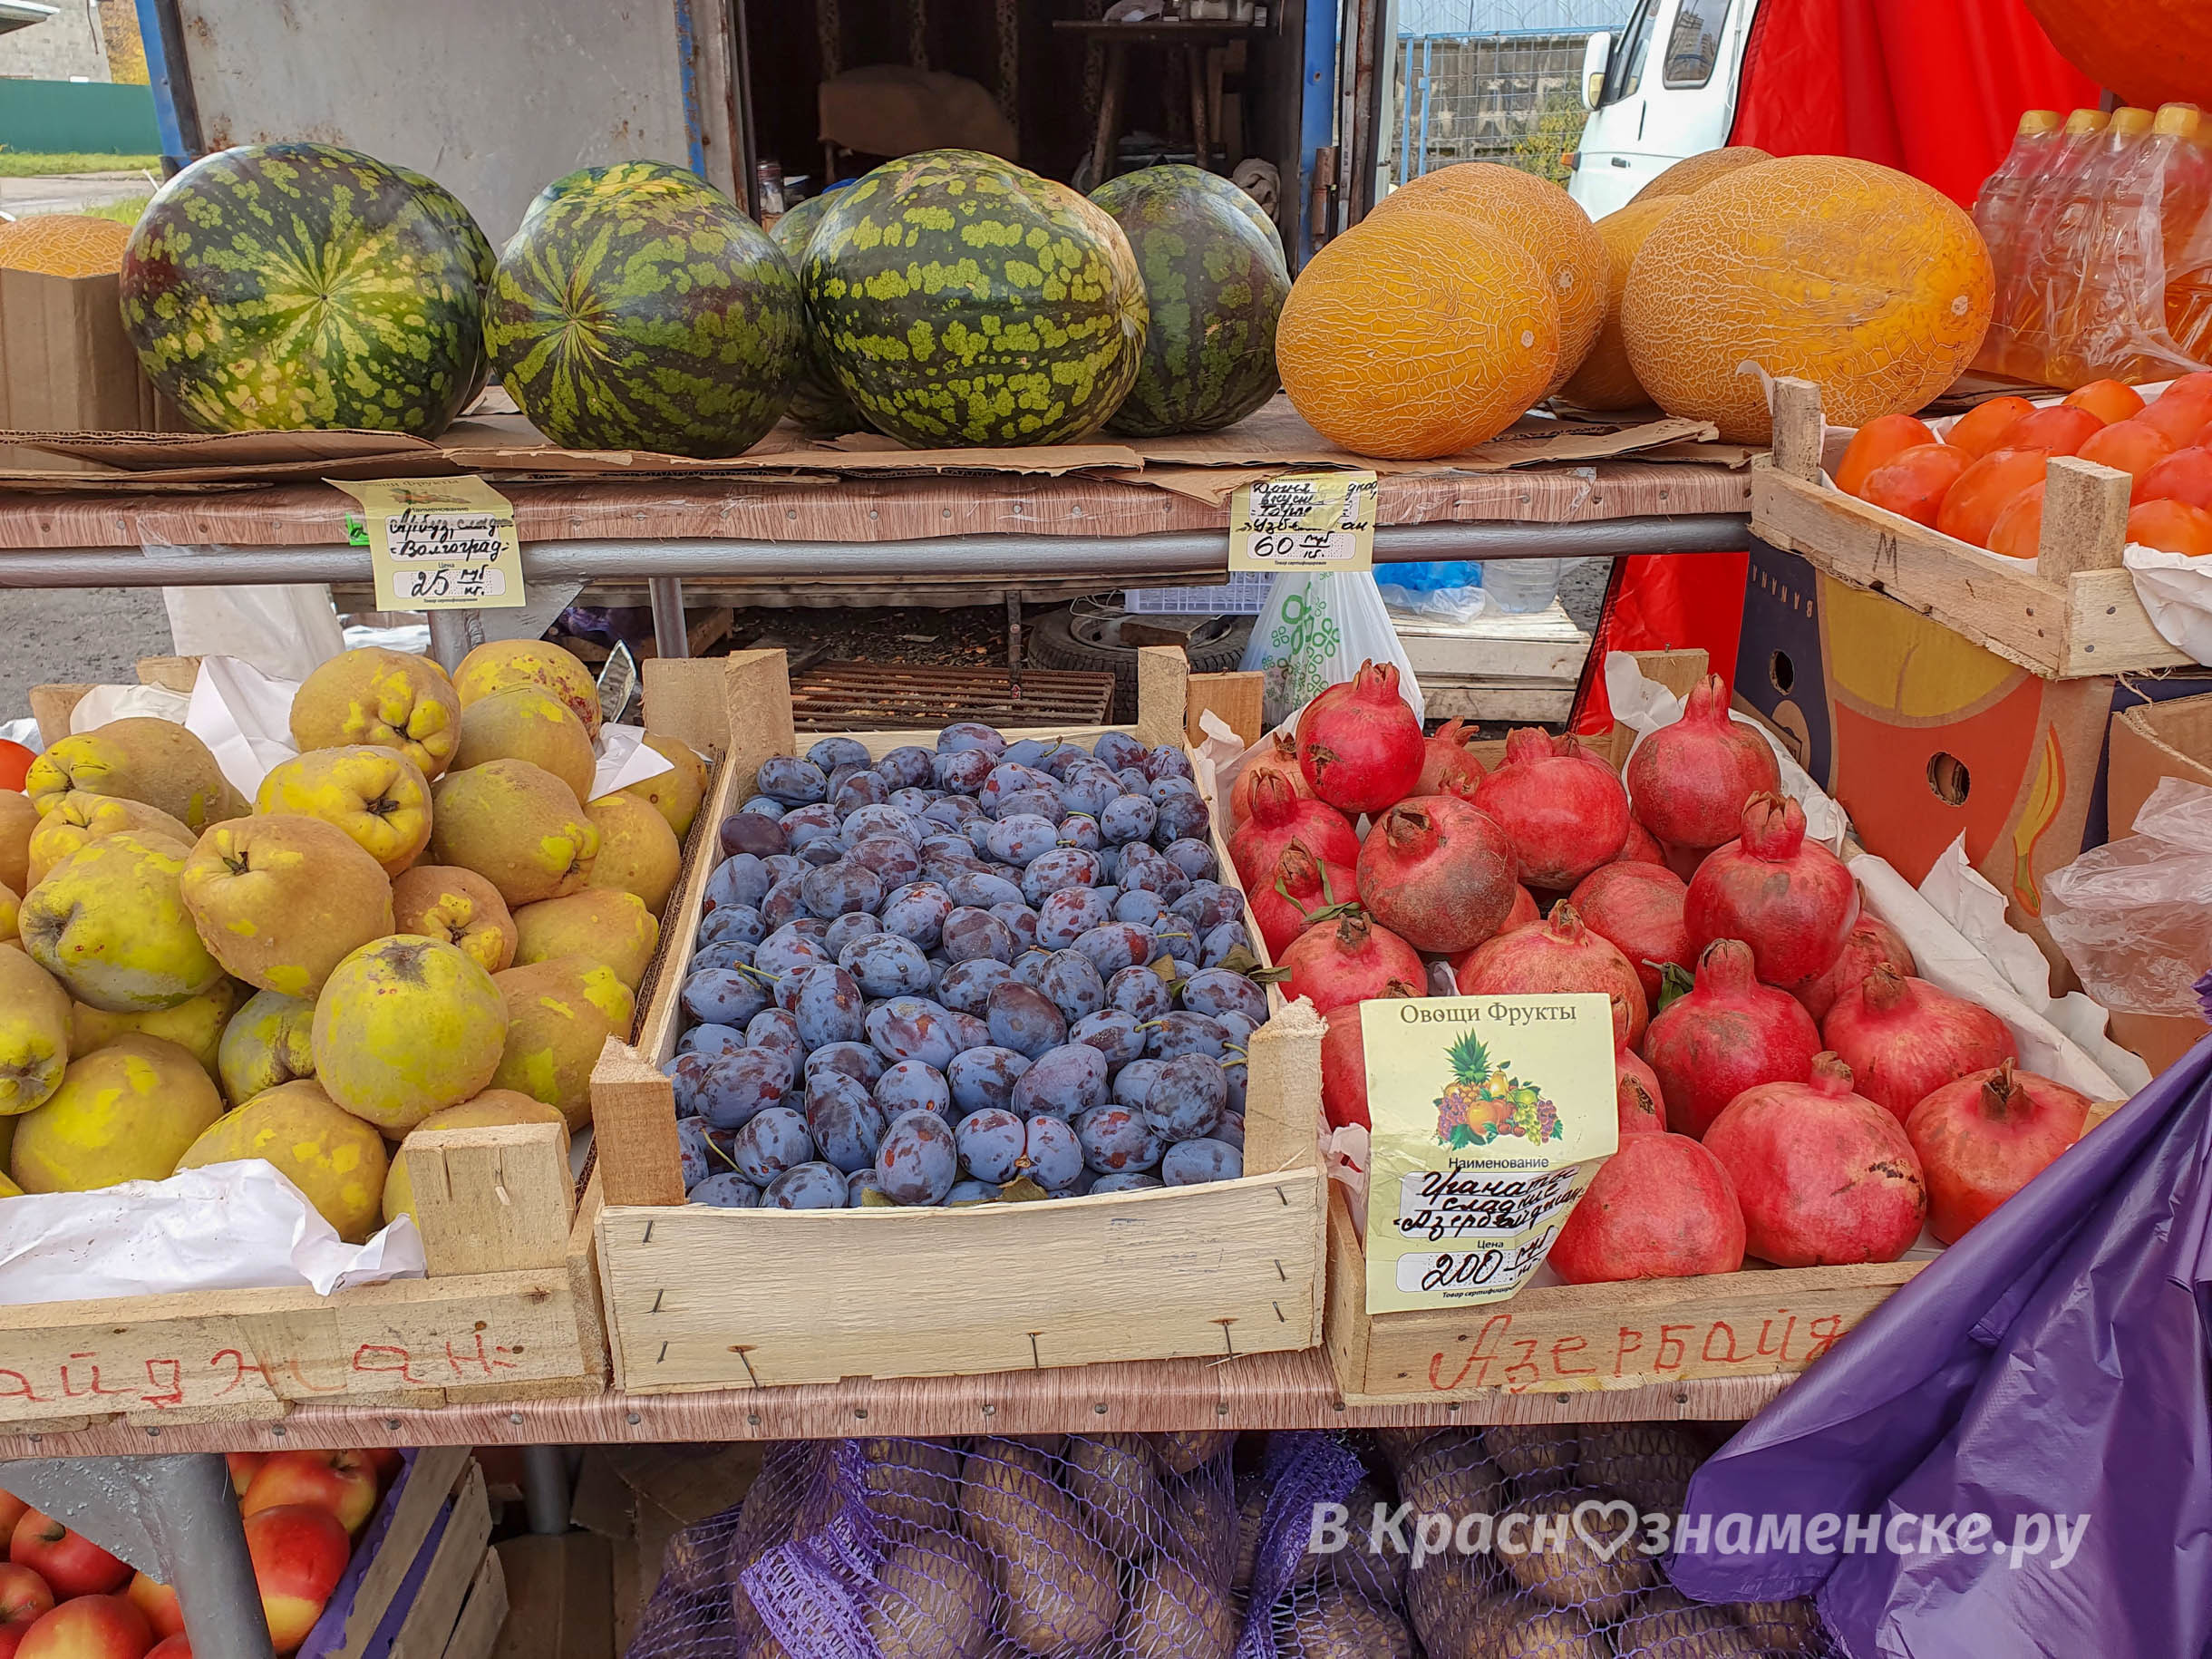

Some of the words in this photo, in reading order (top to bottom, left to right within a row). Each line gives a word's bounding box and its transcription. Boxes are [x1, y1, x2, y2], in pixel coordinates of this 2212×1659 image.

[1254, 536, 1294, 557] 60
[411, 569, 450, 597] 25
[1751, 563, 1814, 618] BANANA
[1401, 1004, 1481, 1024] Овощи
[1488, 1002, 1577, 1026] Фрукты
[1449, 1157, 1549, 1169] Наименование
[1478, 1240, 1504, 1249] Цена
[1421, 1249, 1503, 1291] 200
[1442, 1291, 1465, 1299] Товар
